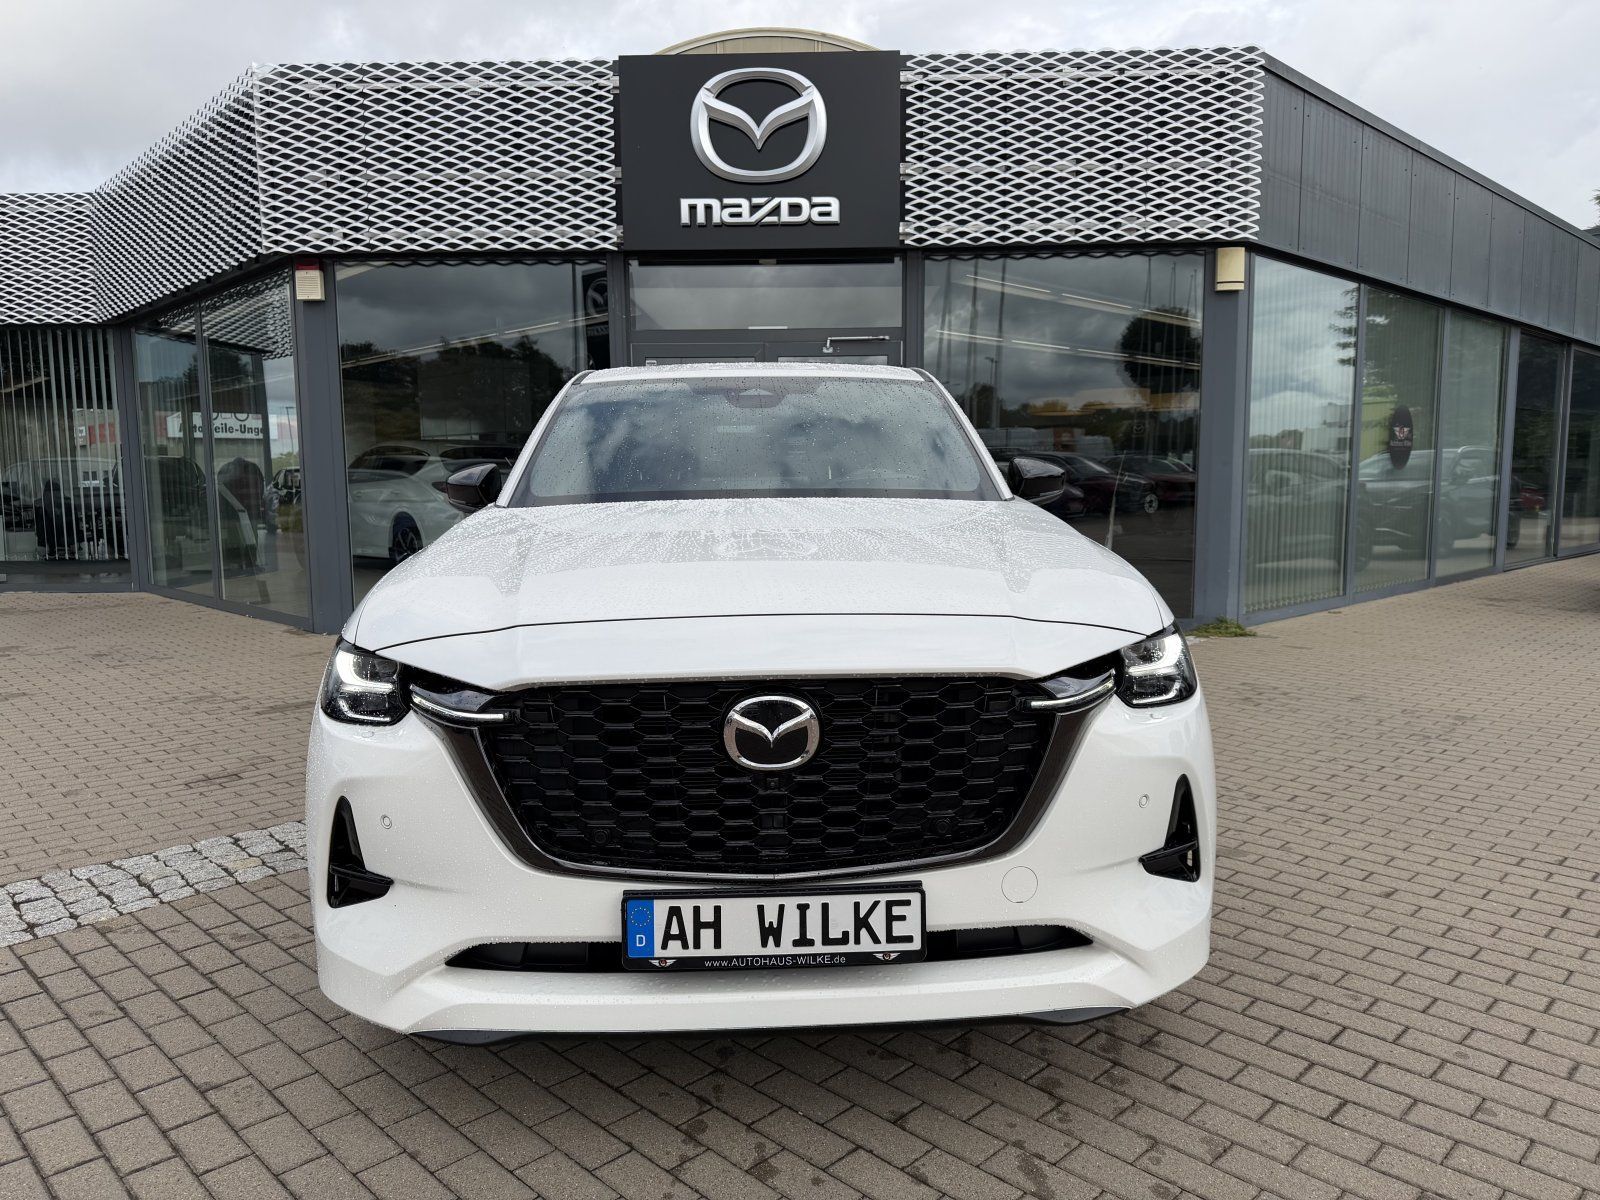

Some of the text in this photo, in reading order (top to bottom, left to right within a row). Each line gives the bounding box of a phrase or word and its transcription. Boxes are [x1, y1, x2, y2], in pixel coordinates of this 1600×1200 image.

[660, 899, 914, 950] AH WILKE
[636, 934, 646, 947] D
[704, 954, 847, 968] www.AUTOHAUS-WILKE.de
